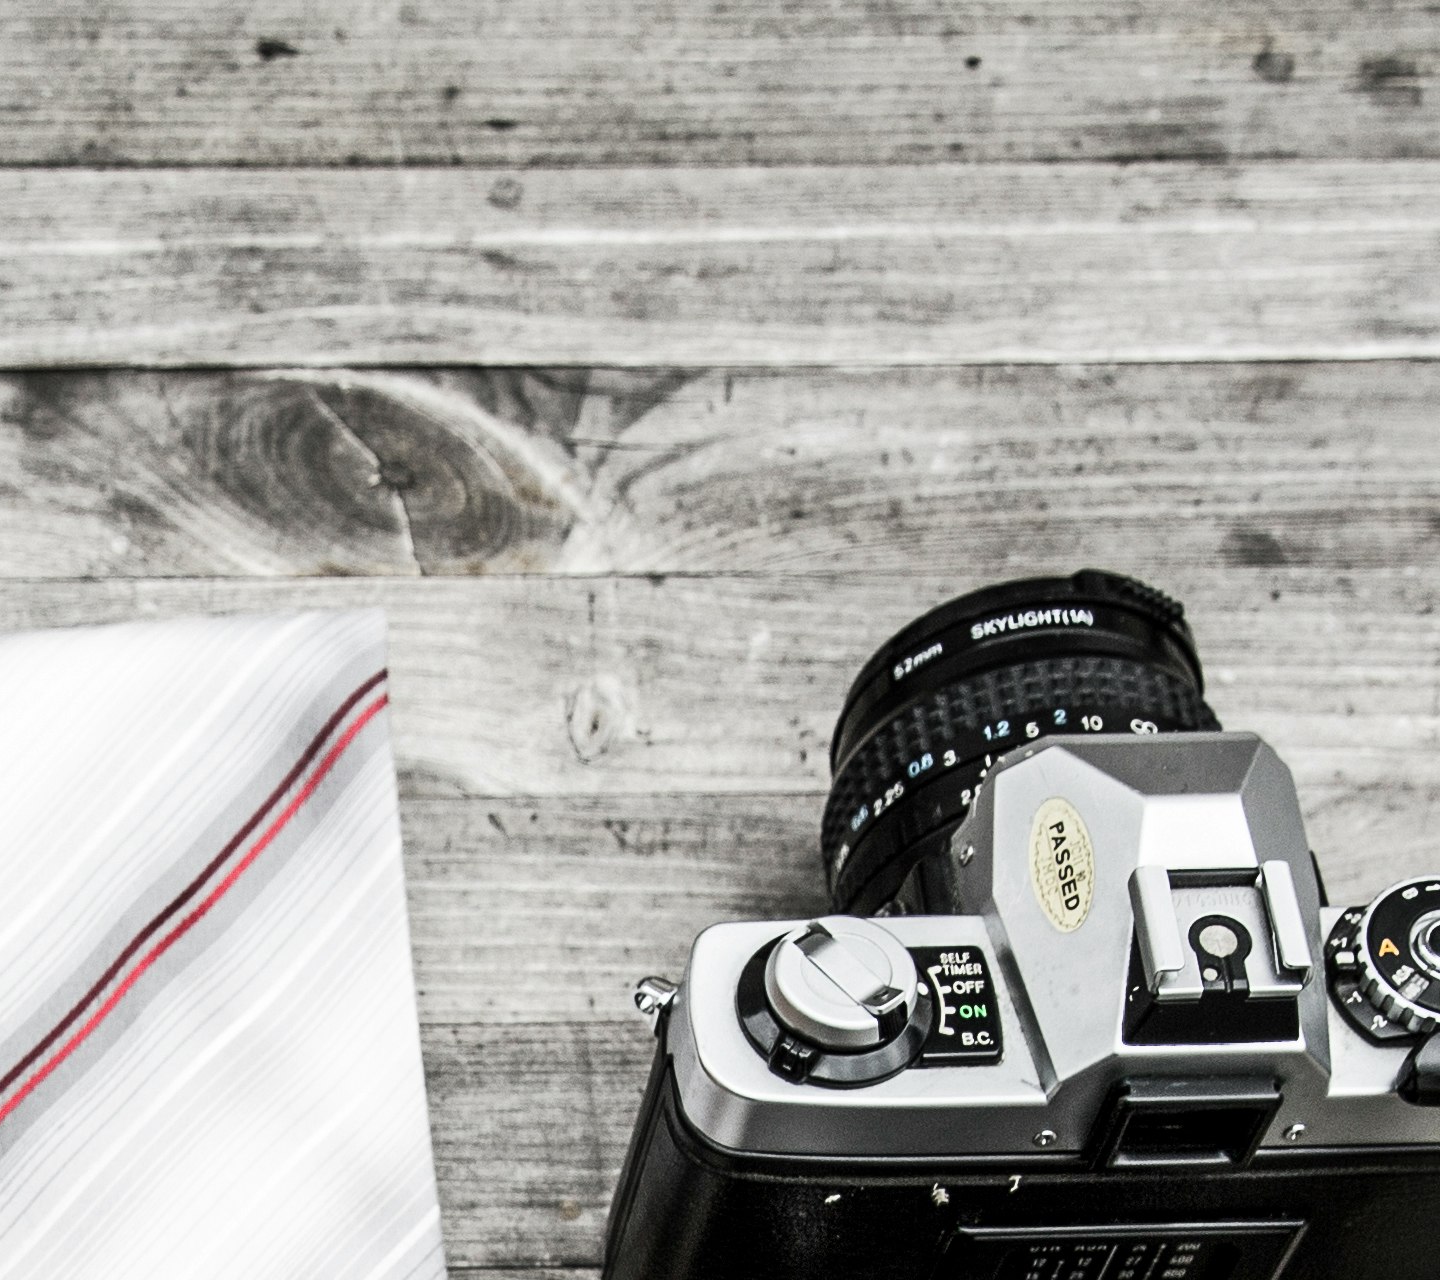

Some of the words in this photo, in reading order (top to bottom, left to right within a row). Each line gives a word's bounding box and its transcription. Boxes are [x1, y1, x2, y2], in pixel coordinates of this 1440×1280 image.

[1054, 709, 1067, 725] 2
[1081, 715, 1103, 731] 10
[943, 749, 957, 767] 3
[1049, 821, 1080, 911] PASSED
[1379, 938, 1400, 957] A
[940, 952, 970, 964] SELF
[942, 963, 983, 976] TIMER
[953, 981, 984, 994] OFF
[959, 1004, 988, 1018] ON
[962, 1031, 994, 1045] B.C.
